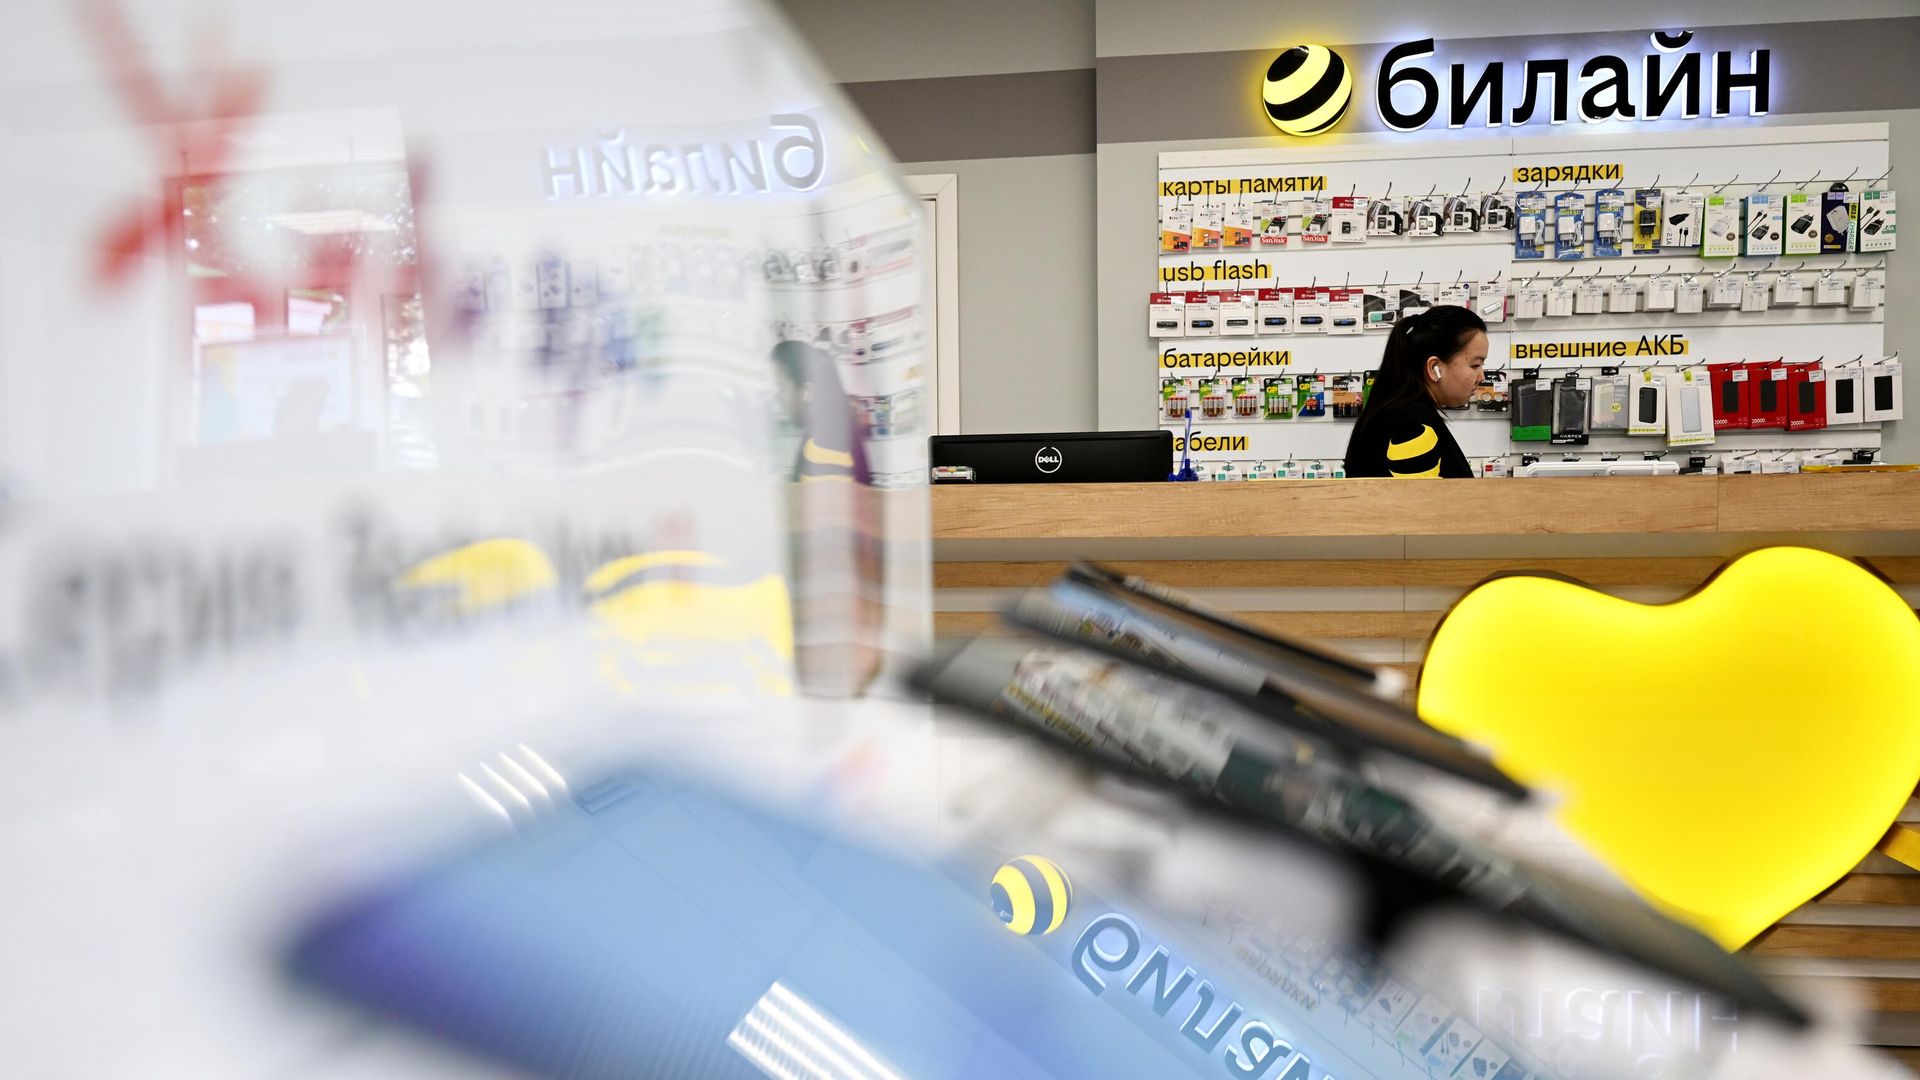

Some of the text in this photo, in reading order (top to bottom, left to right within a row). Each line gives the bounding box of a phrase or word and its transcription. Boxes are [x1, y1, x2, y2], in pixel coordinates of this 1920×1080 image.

[1376, 30, 1770, 132] билайн
[1517, 164, 1619, 187] зарядки
[1163, 176, 1324, 201] карты памяти
[1848, 221, 1856, 250] CHARGER
[1163, 259, 1269, 281] usb flash
[1163, 346, 1289, 372] батарейки
[1515, 334, 1685, 359] внешние АКБ
[1173, 431, 1246, 451] абели
